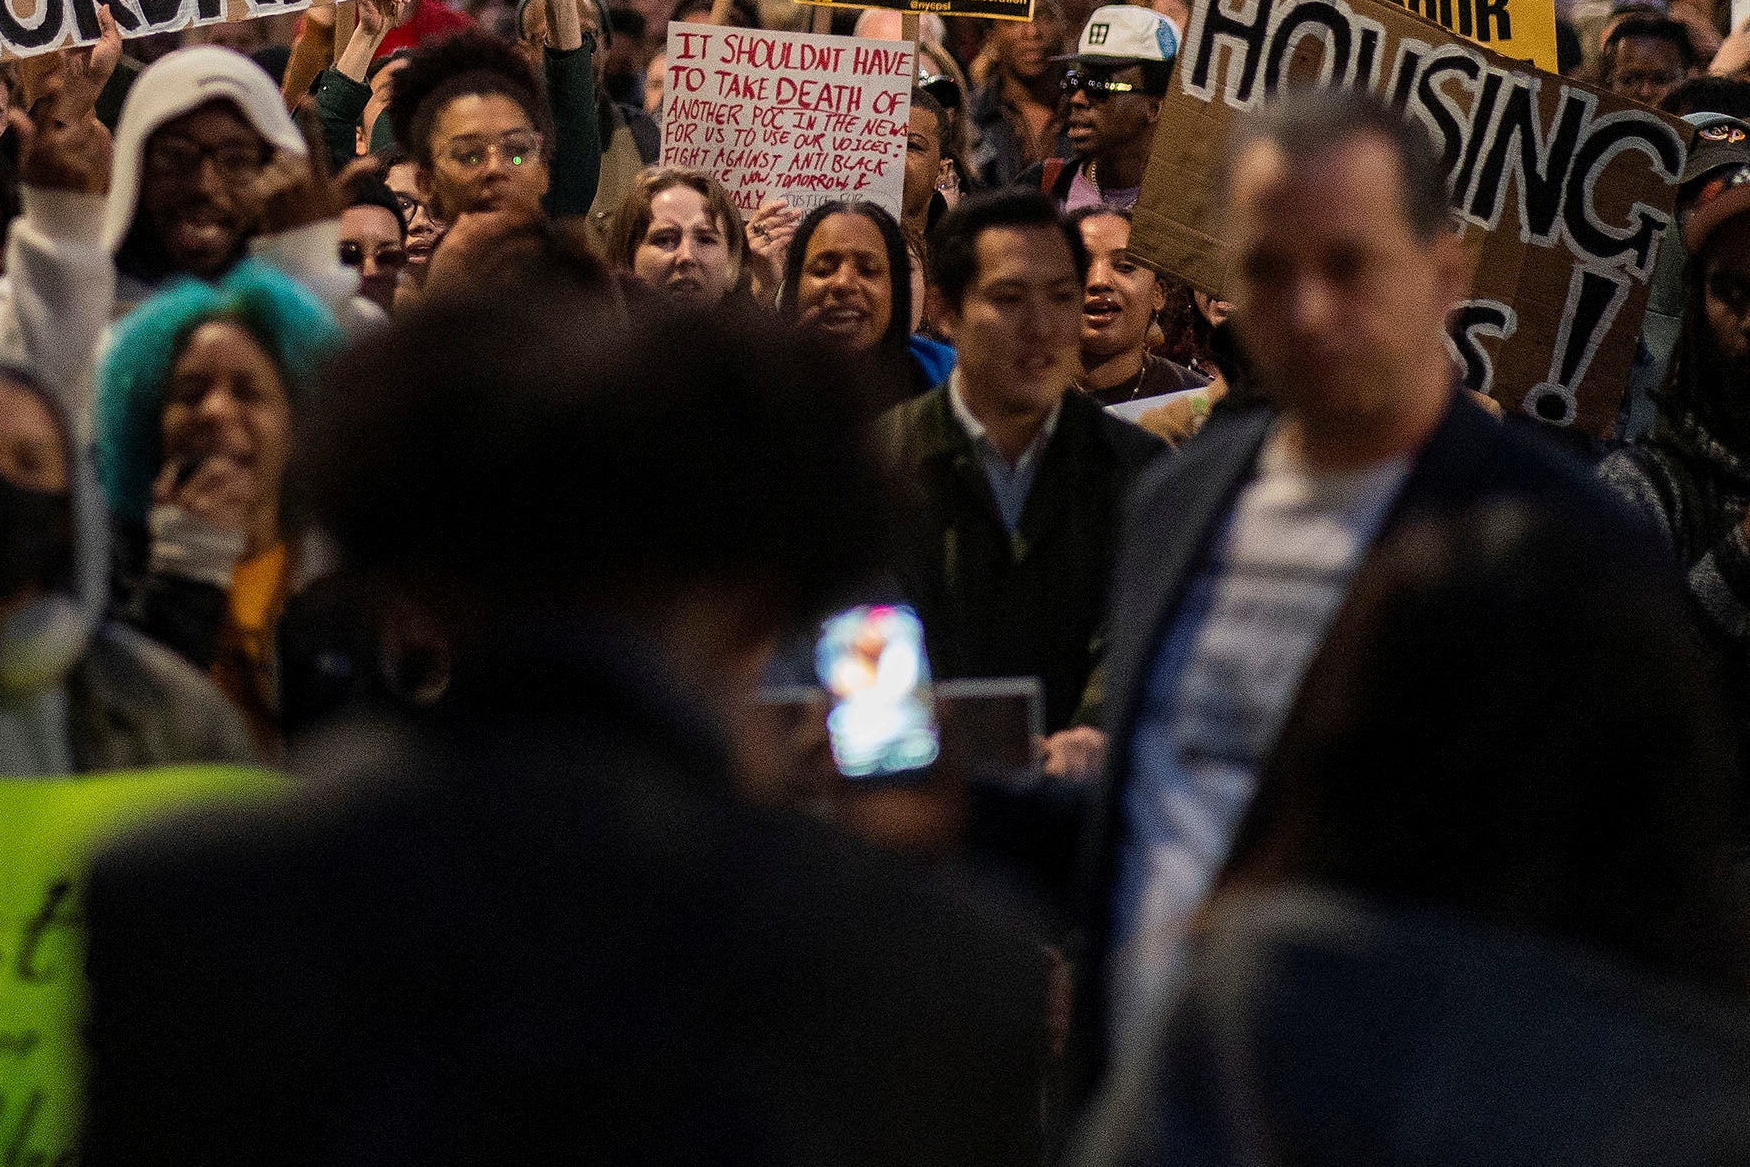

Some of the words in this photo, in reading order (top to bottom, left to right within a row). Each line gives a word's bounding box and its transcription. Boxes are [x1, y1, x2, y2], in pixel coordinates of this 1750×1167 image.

[676, 33, 712, 60] IT
[720, 34, 846, 73] SHOULDNT
[852, 46, 913, 77] HAVE
[668, 65, 705, 92] TO
[714, 70, 770, 101] TAKE
[775, 77, 862, 112] DEATH
[872, 90, 908, 115] OF
[667, 95, 743, 126] ANOTHER
[752, 105, 784, 129] POC
[792, 112, 817, 132] IN
[823, 111, 861, 133] THE
[862, 117, 909, 138] NEWS
[665, 121, 698, 145] FOR
[704, 127, 725, 142] US
[735, 128, 756, 147] TO
[763, 129, 788, 146] USE
[794, 134, 823, 149] OUR
[832, 136, 902, 158] VOICES:
[665, 147, 710, 167] FIGHT
[713, 148, 782, 170] AGAINST
[788, 152, 828, 173] ANTI
[832, 155, 888, 177] BLACK
[775, 173, 849, 190] TOMORROW
[854, 173, 871, 190] &
